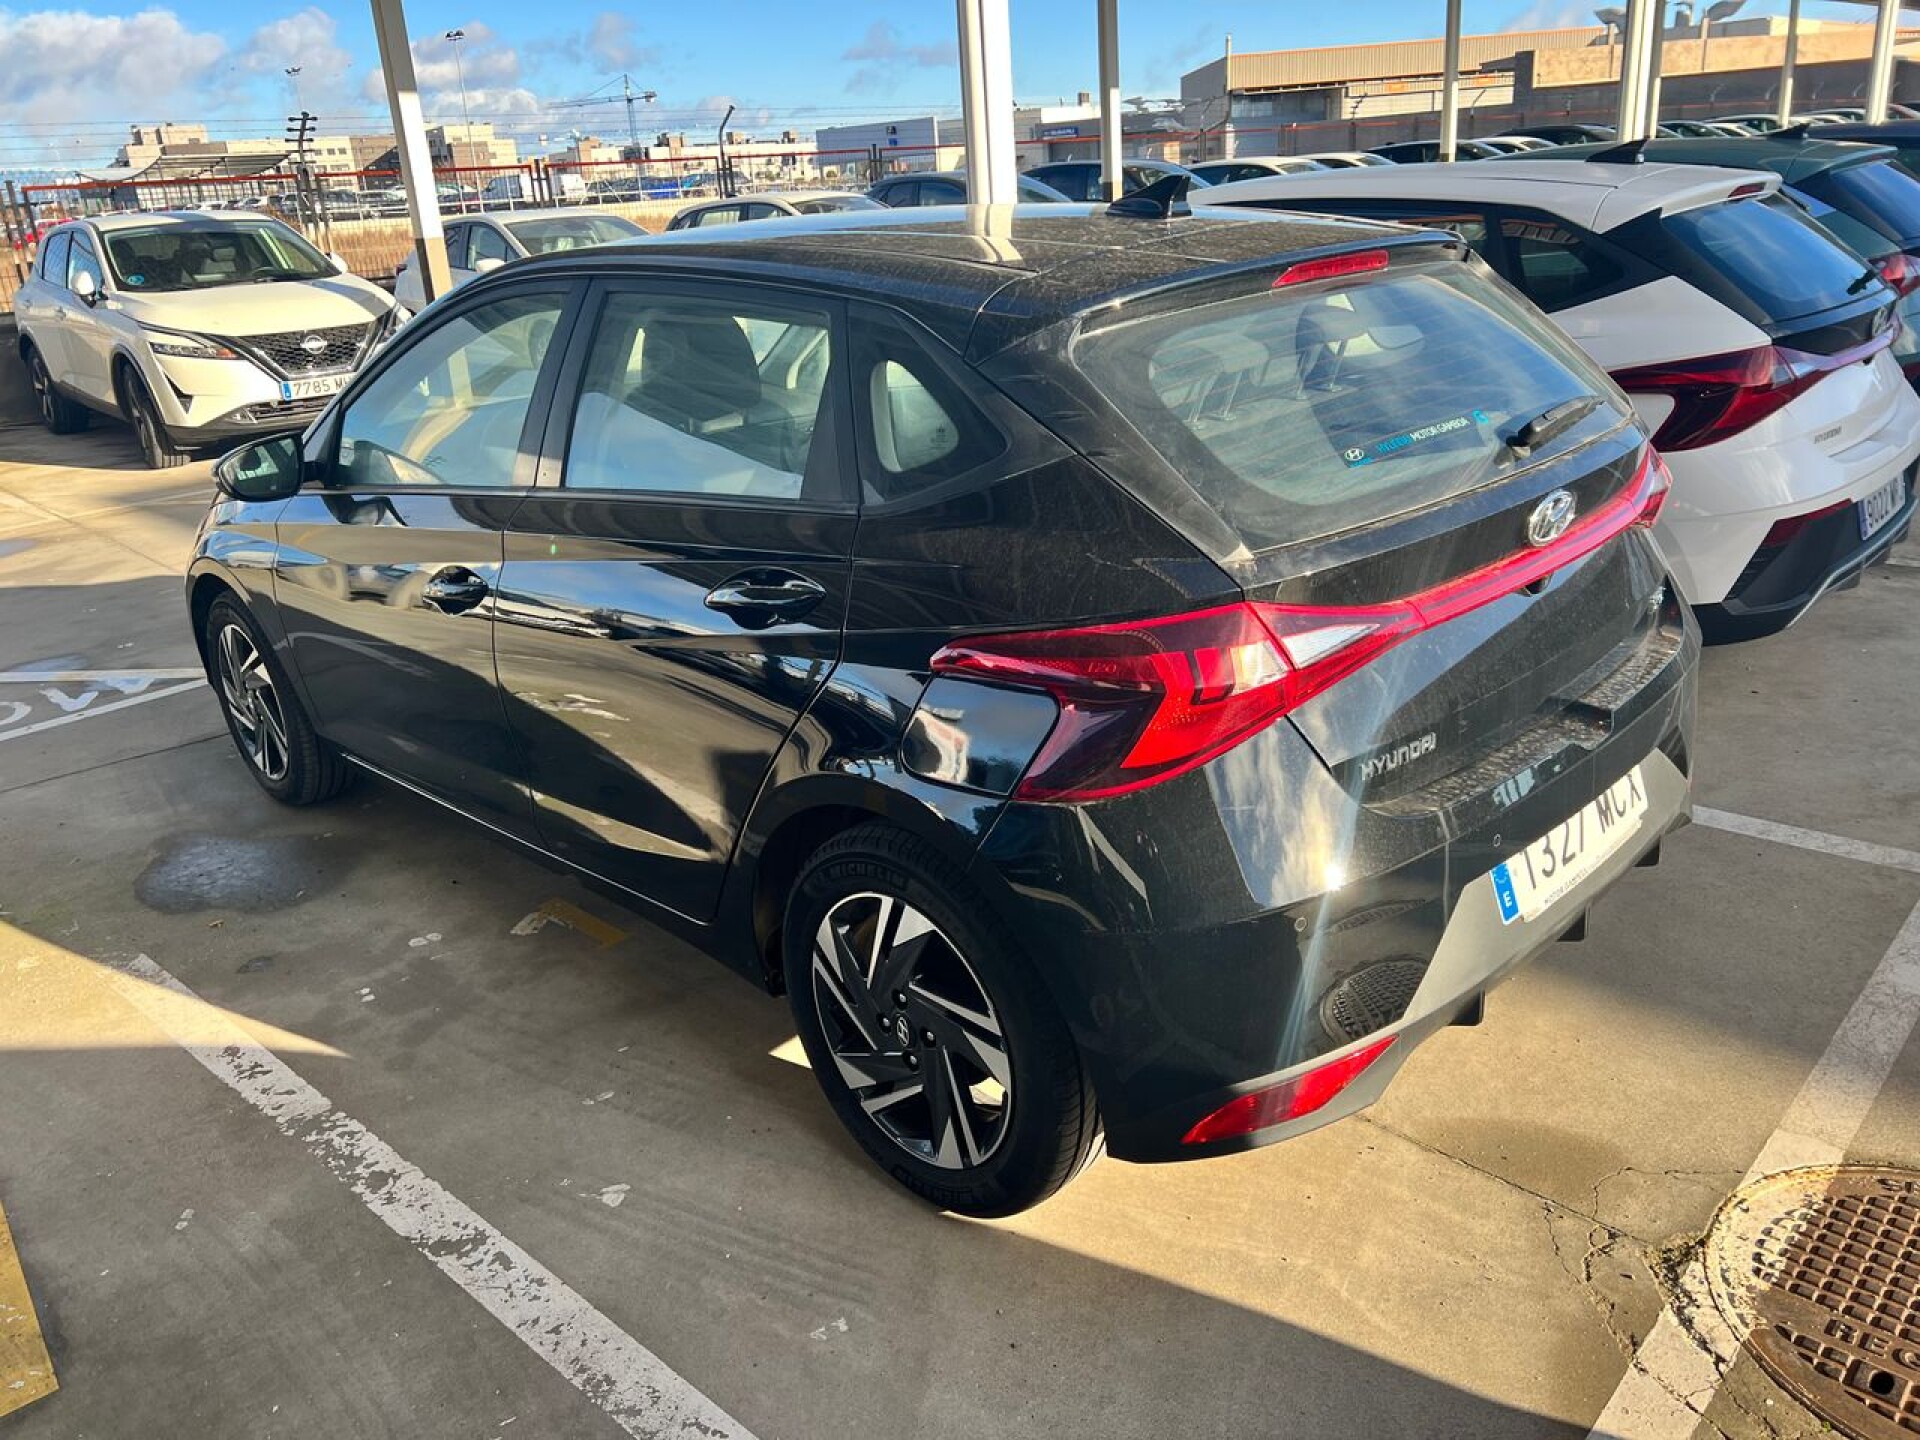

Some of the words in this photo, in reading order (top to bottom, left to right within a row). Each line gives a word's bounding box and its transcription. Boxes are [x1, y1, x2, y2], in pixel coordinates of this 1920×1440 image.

[294, 380, 330, 396] 7785
[1361, 731, 1437, 781] HYUNDAI
[1518, 808, 1585, 890] 1327
[1502, 890, 1513, 908] E
